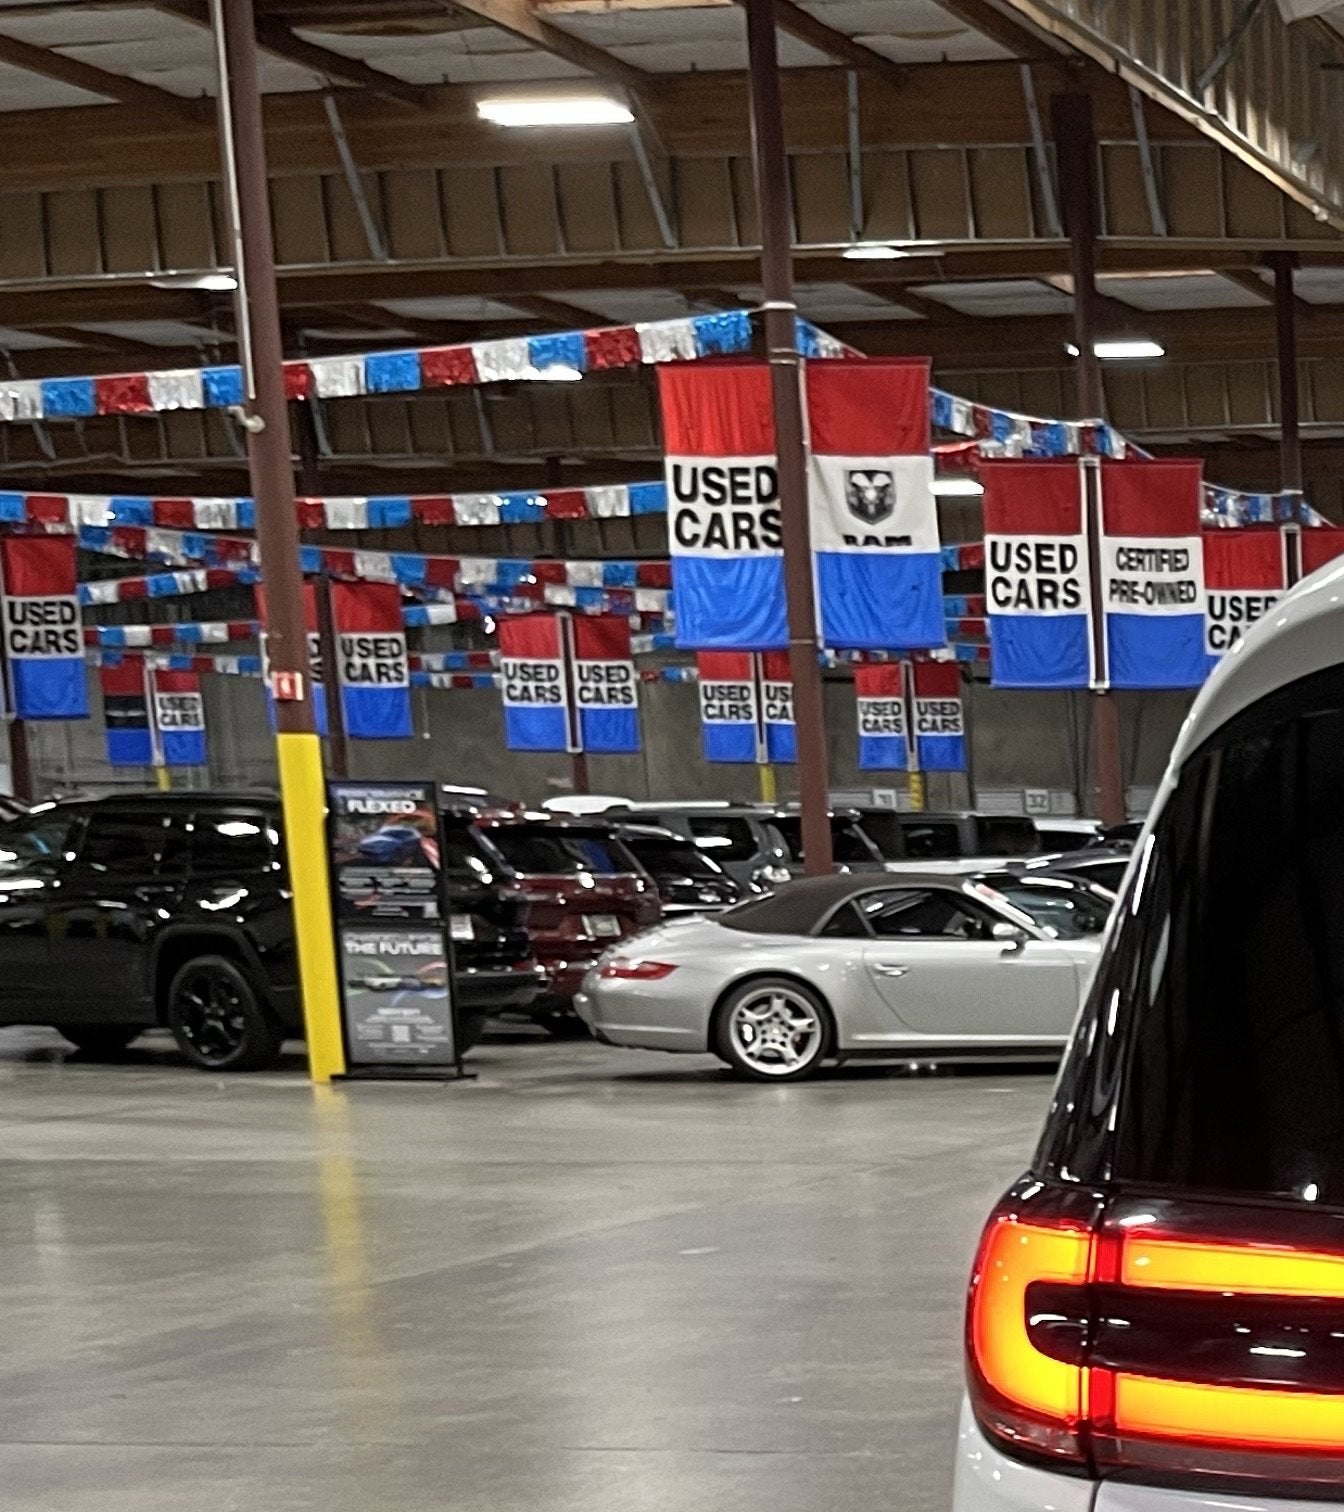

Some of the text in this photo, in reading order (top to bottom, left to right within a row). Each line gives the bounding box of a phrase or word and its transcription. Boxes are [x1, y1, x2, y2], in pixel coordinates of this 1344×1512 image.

[672, 463, 779, 506] USED
[674, 508, 784, 550] CARS
[842, 534, 913, 547] RAM
[990, 541, 1078, 575] USED
[1116, 547, 1190, 572] CERTIFIED
[991, 577, 1081, 610] CARS
[1109, 579, 1197, 605] PRE-OWNED
[8, 601, 76, 625] USED
[10, 629, 79, 653] CARS
[340, 638, 403, 658] USED
[345, 662, 404, 682] CARS
[504, 662, 560, 682] USED
[577, 664, 631, 683] USED
[506, 684, 562, 702] CARS
[578, 685, 633, 704] CARS
[703, 684, 751, 701] USED
[704, 703, 753, 721] CARS
[861, 701, 901, 717] USED
[917, 701, 960, 717] USED
[862, 718, 903, 733] CARS
[918, 718, 961, 733] CARS
[345, 942, 442, 955] THE FUTURE
